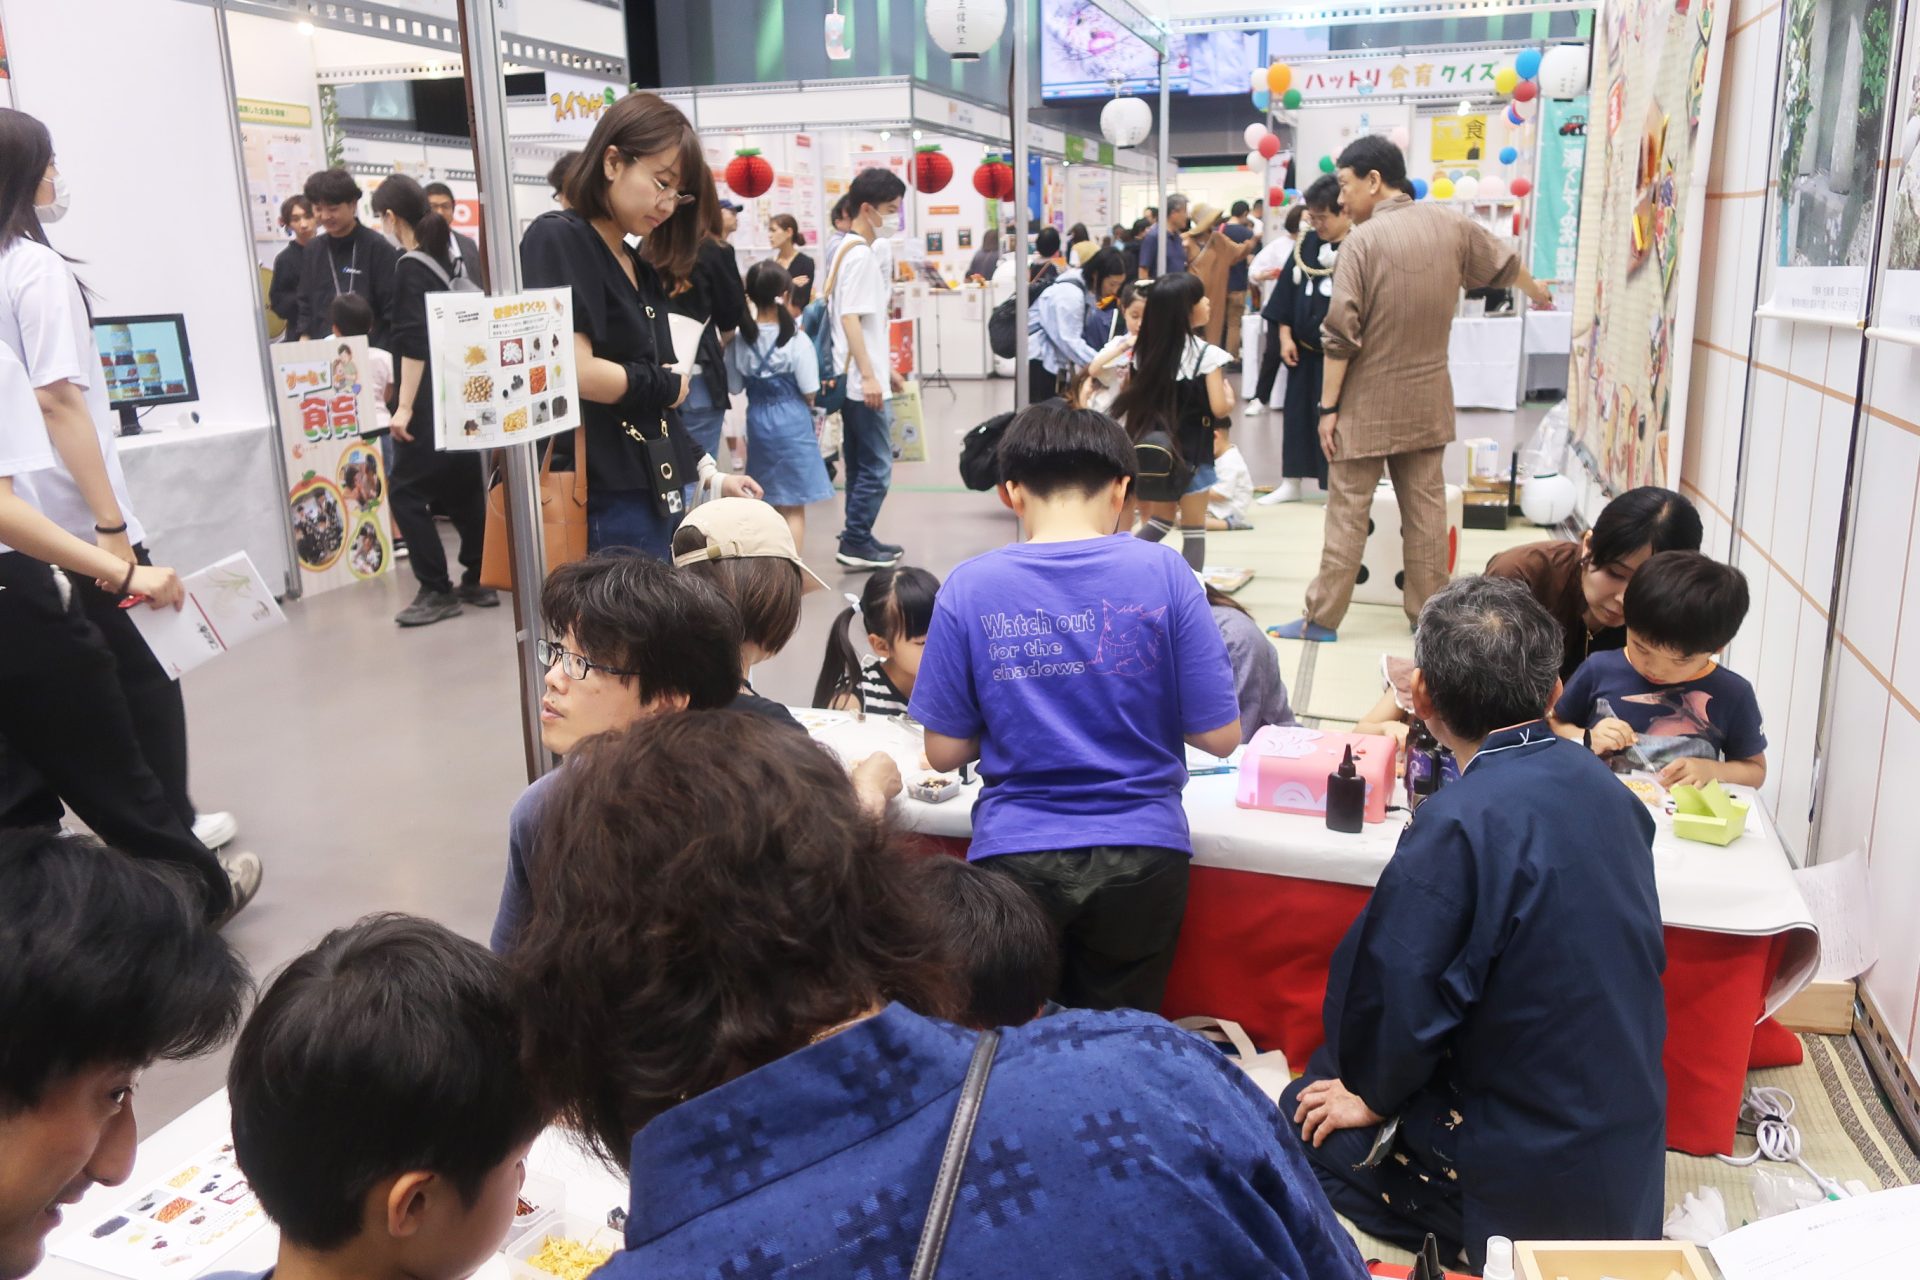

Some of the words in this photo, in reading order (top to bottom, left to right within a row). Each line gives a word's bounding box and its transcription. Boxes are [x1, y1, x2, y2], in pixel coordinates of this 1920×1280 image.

[1306, 69, 1381, 89] ハットリ
[1388, 63, 1434, 89] 食育
[1441, 62, 1498, 83] クイズ
[1465, 119, 1486, 140] 食
[300, 393, 358, 440] 食育
[981, 609, 1051, 640] Watch
[1056, 609, 1096, 633] out
[989, 643, 1019, 661] for
[1024, 639, 1063, 657] the
[993, 660, 1085, 681] shadows
